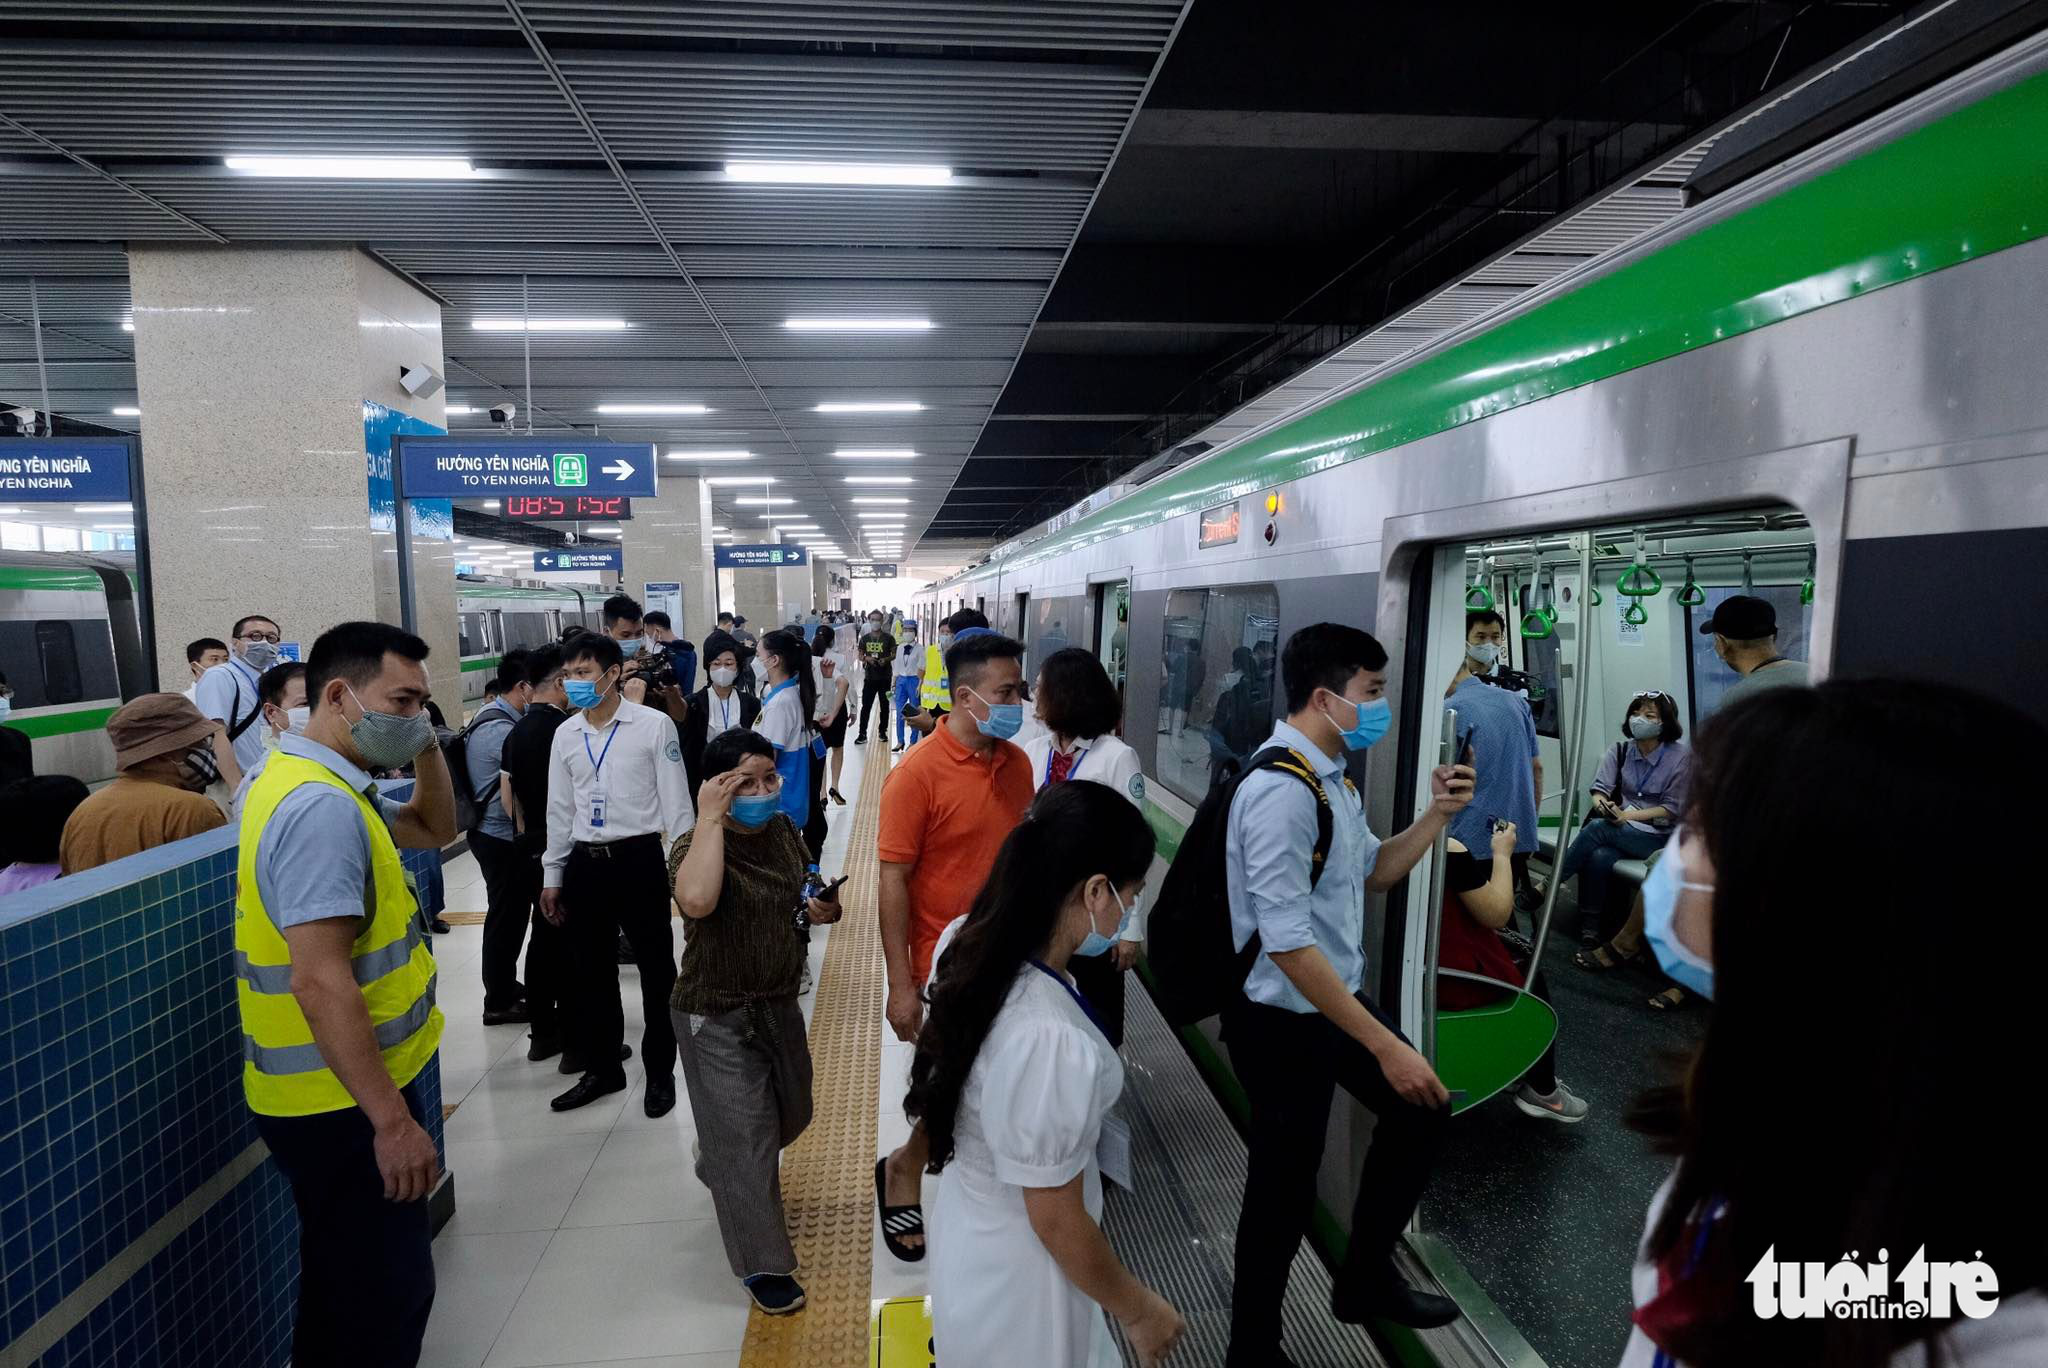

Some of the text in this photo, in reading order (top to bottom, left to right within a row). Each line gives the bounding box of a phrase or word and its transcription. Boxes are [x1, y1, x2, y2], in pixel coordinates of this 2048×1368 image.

[23, 455, 49, 473] YÊN
[51, 456, 92, 473] NGHĨA
[436, 453, 550, 471] HƯỚNG YÊN NGHĨA
[28, 478, 73, 488] NGHIA
[461, 475, 550, 485] TO YEN NGHIA
[866, 642, 883, 652] SEEK
